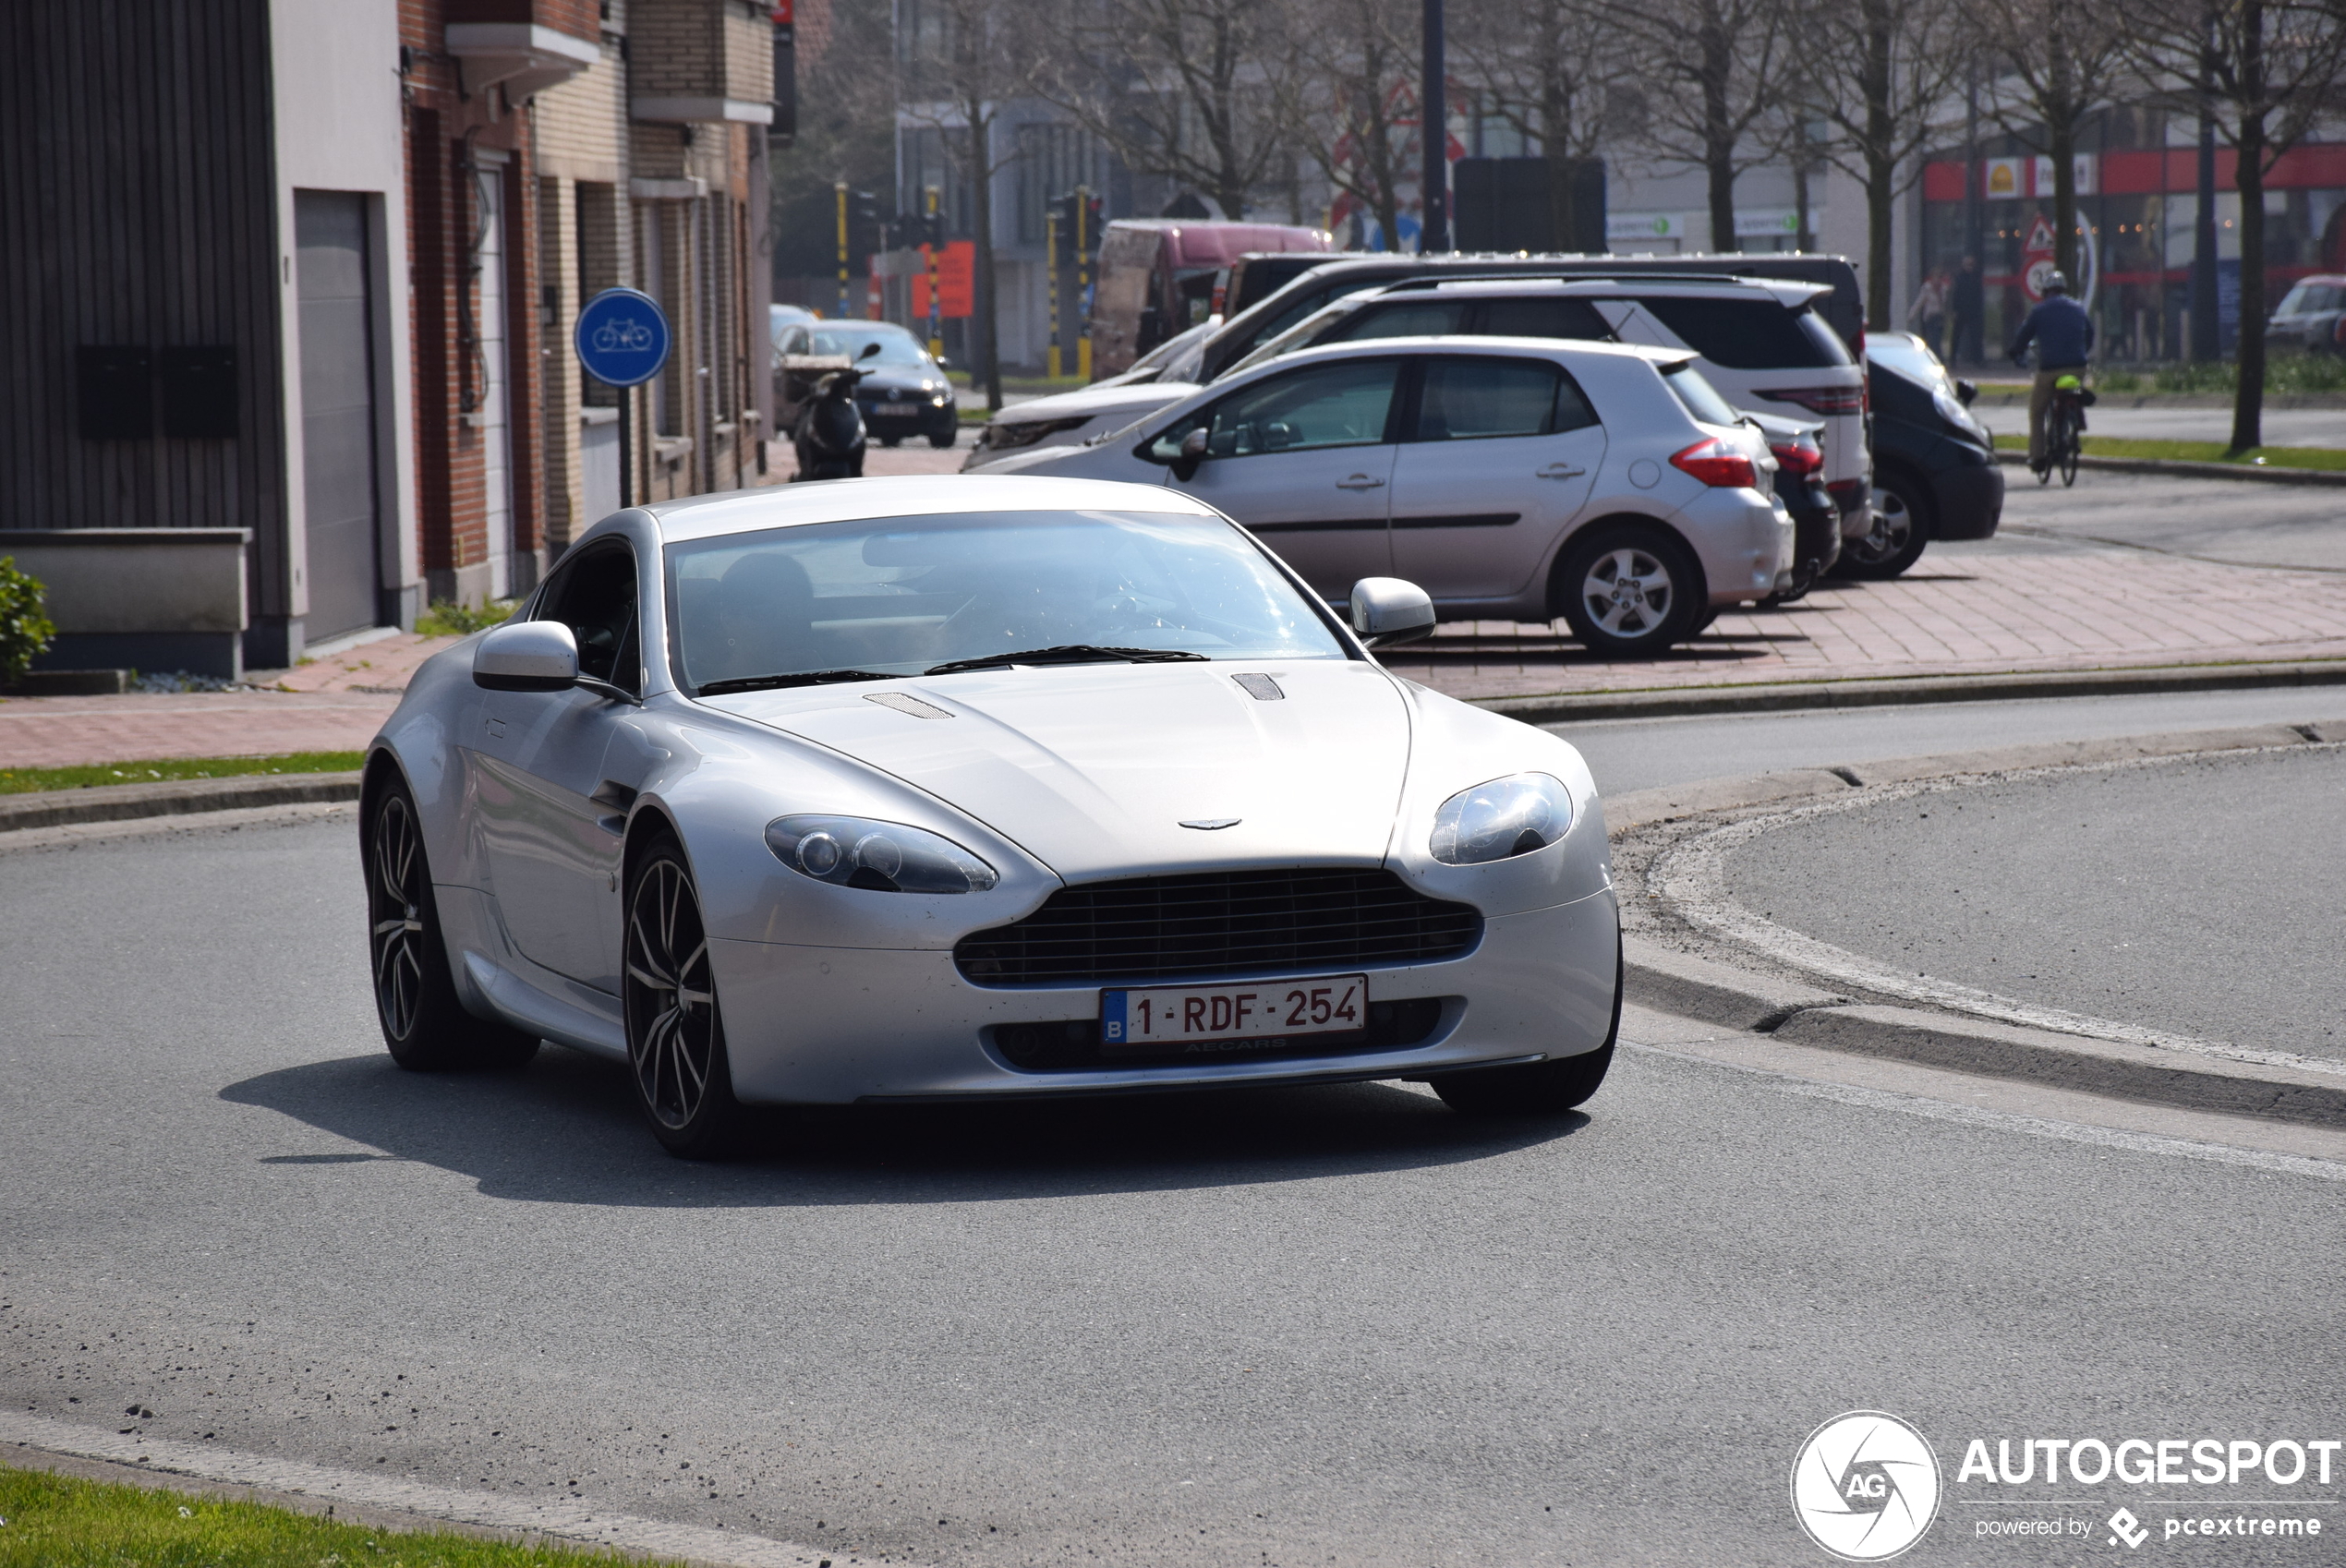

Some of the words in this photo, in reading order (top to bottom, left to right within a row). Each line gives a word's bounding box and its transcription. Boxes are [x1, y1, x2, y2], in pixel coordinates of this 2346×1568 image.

[1107, 1020, 1122, 1039] B
[1137, 985, 1357, 1034] 1-RDF-254
[1184, 1038, 1287, 1053] AECARS
